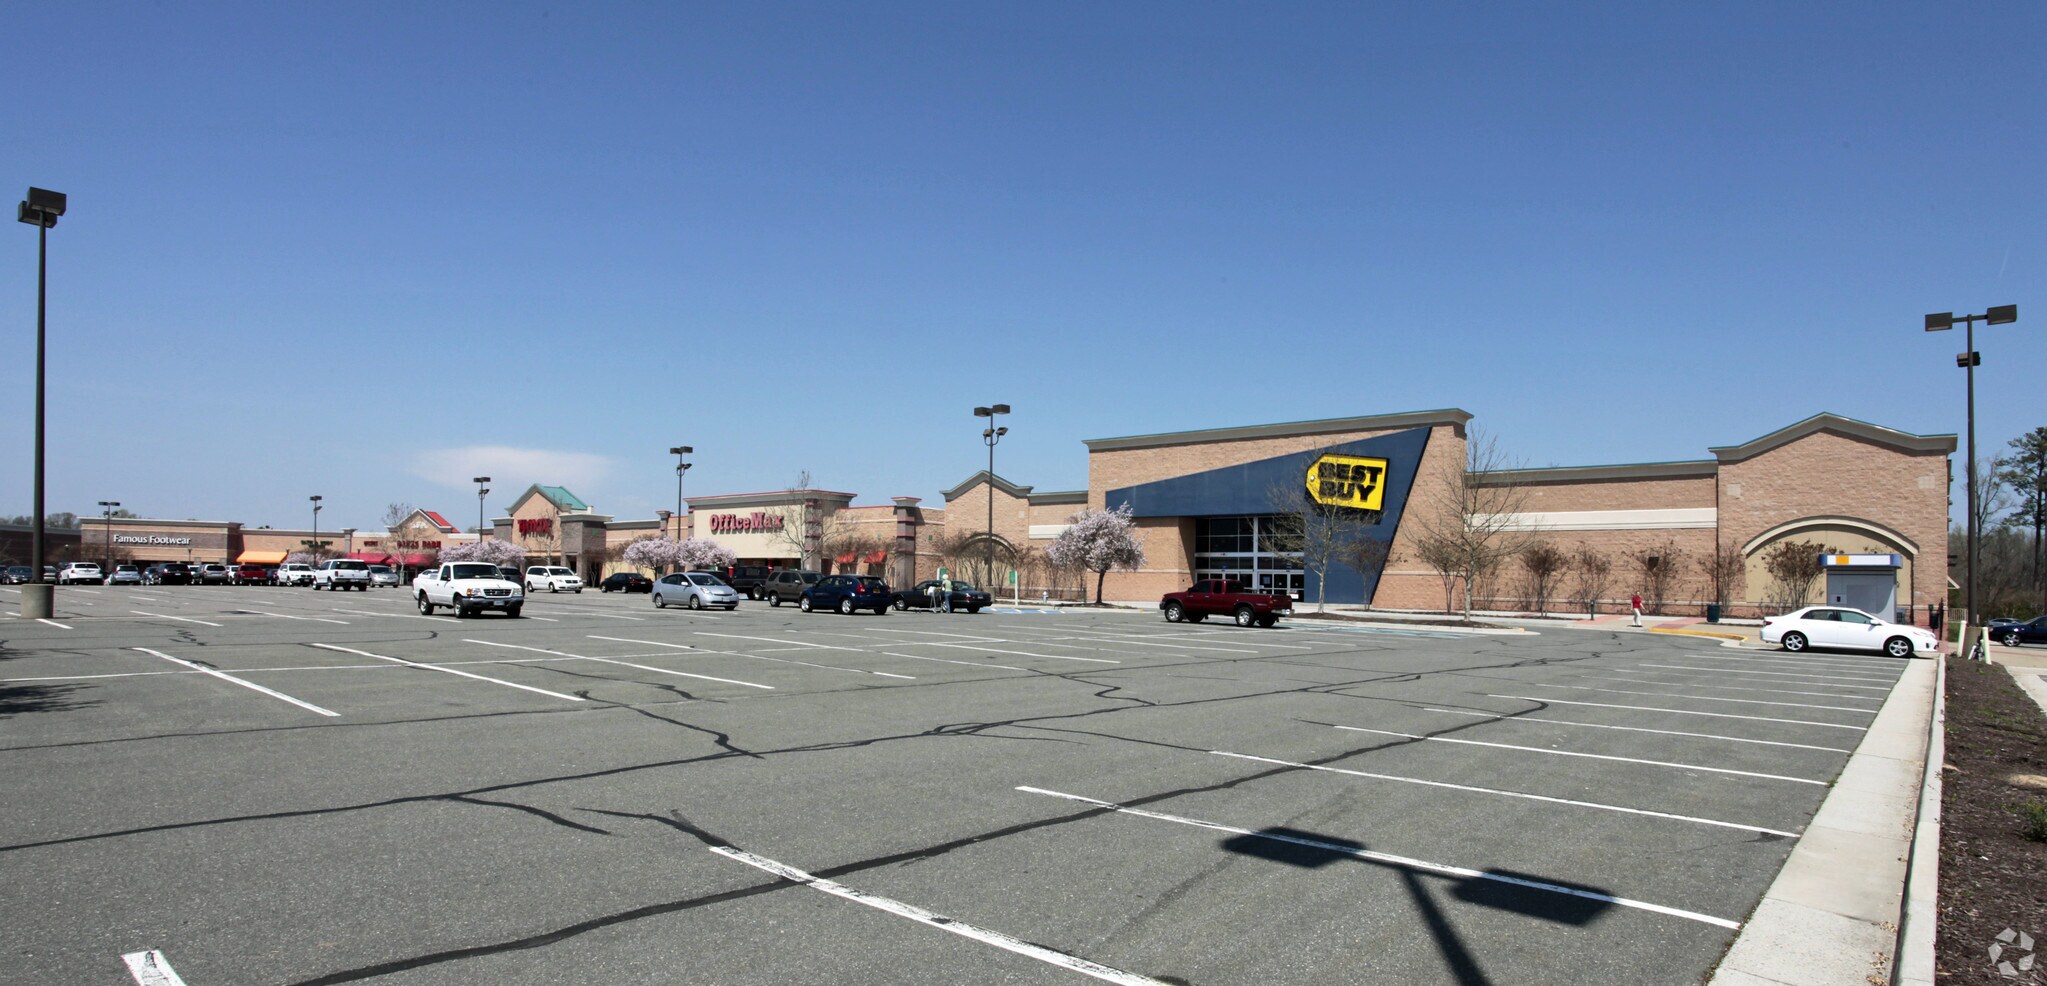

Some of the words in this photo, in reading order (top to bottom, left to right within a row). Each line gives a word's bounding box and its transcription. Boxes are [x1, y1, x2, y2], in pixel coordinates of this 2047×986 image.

[1319, 462, 1383, 484] BEST
[1320, 480, 1376, 502] BUY
[710, 512, 784, 531] OfficeMax
[113, 534, 148, 543] Famous
[149, 535, 191, 545] Footwear
